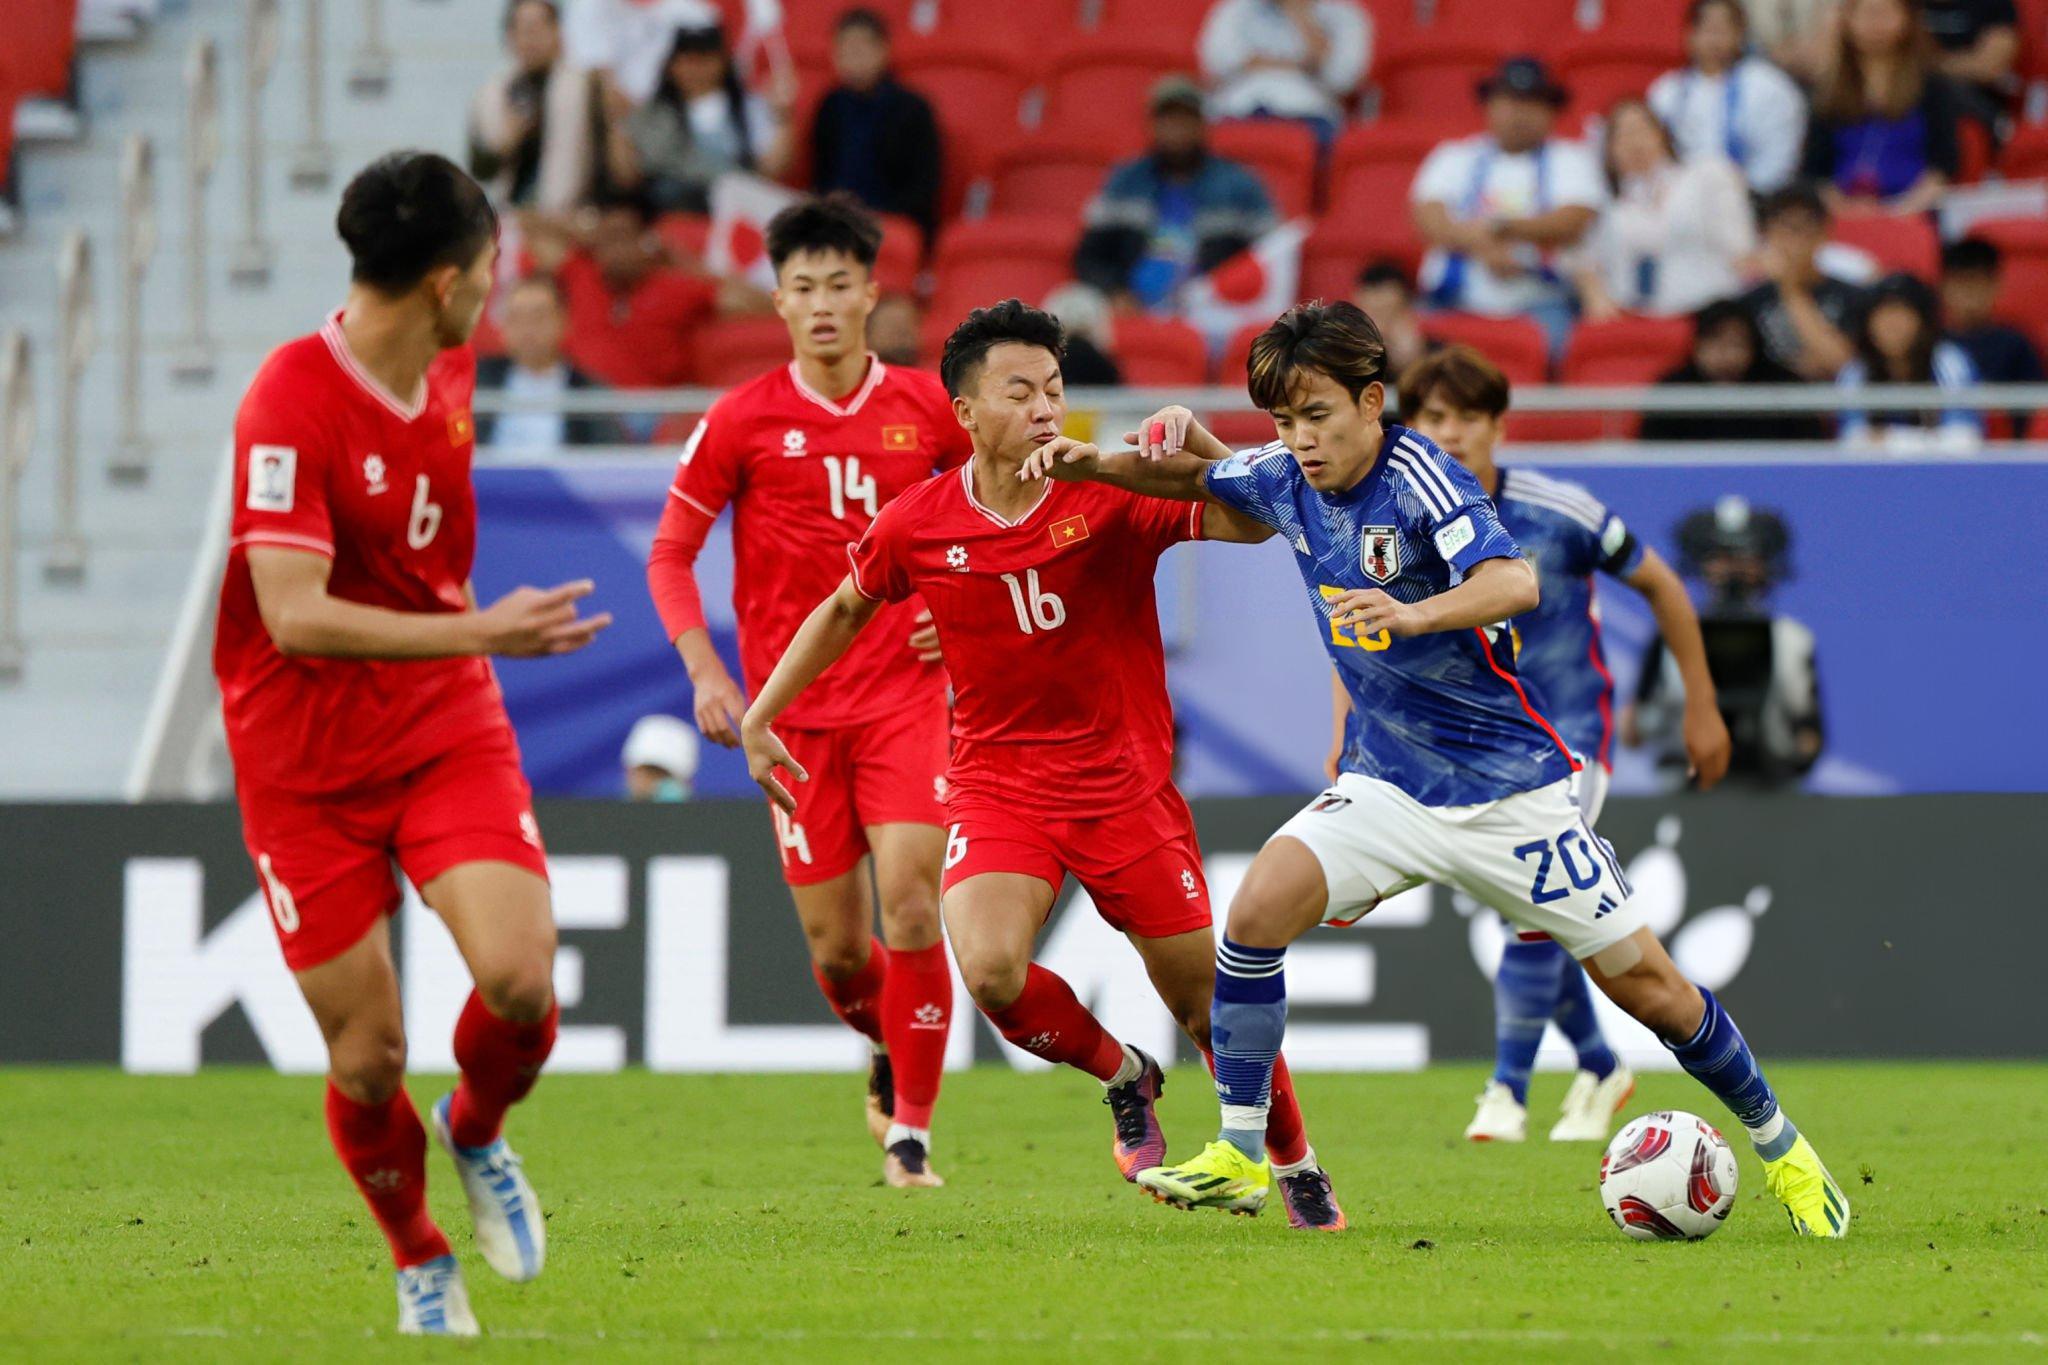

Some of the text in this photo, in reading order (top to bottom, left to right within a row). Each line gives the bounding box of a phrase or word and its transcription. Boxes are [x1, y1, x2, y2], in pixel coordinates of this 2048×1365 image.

[407, 473, 443, 550] 6
[823, 455, 879, 519] 14
[1000, 568, 1066, 634] 16
[258, 851, 301, 934] 6
[1513, 828, 1602, 905] 20
